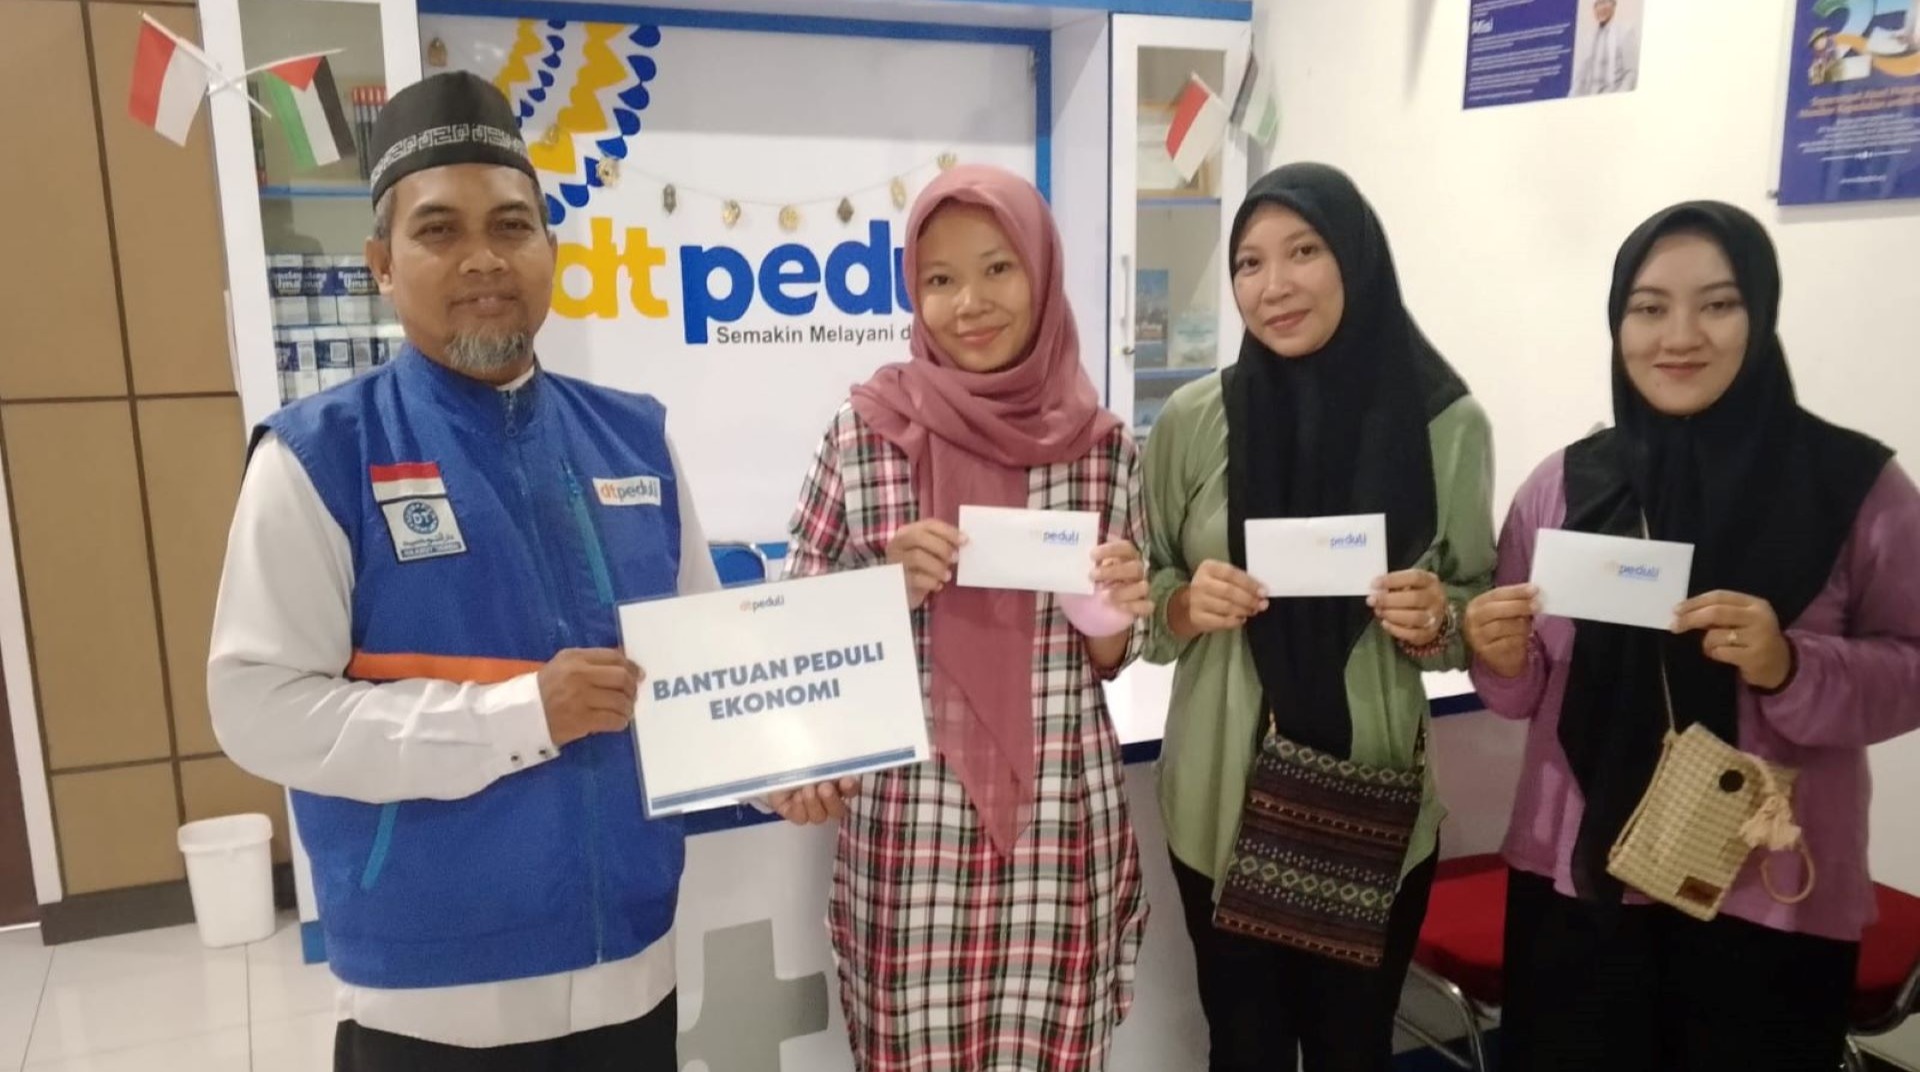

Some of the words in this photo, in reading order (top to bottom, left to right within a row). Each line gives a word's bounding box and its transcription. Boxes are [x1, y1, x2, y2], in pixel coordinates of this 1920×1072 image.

[716, 325, 802, 344] Semakin
[809, 324, 894, 346] Melayani
[652, 658, 789, 701] BANTUAN
[793, 641, 885, 676] PEDULI
[709, 678, 841, 721] EKONOMI
